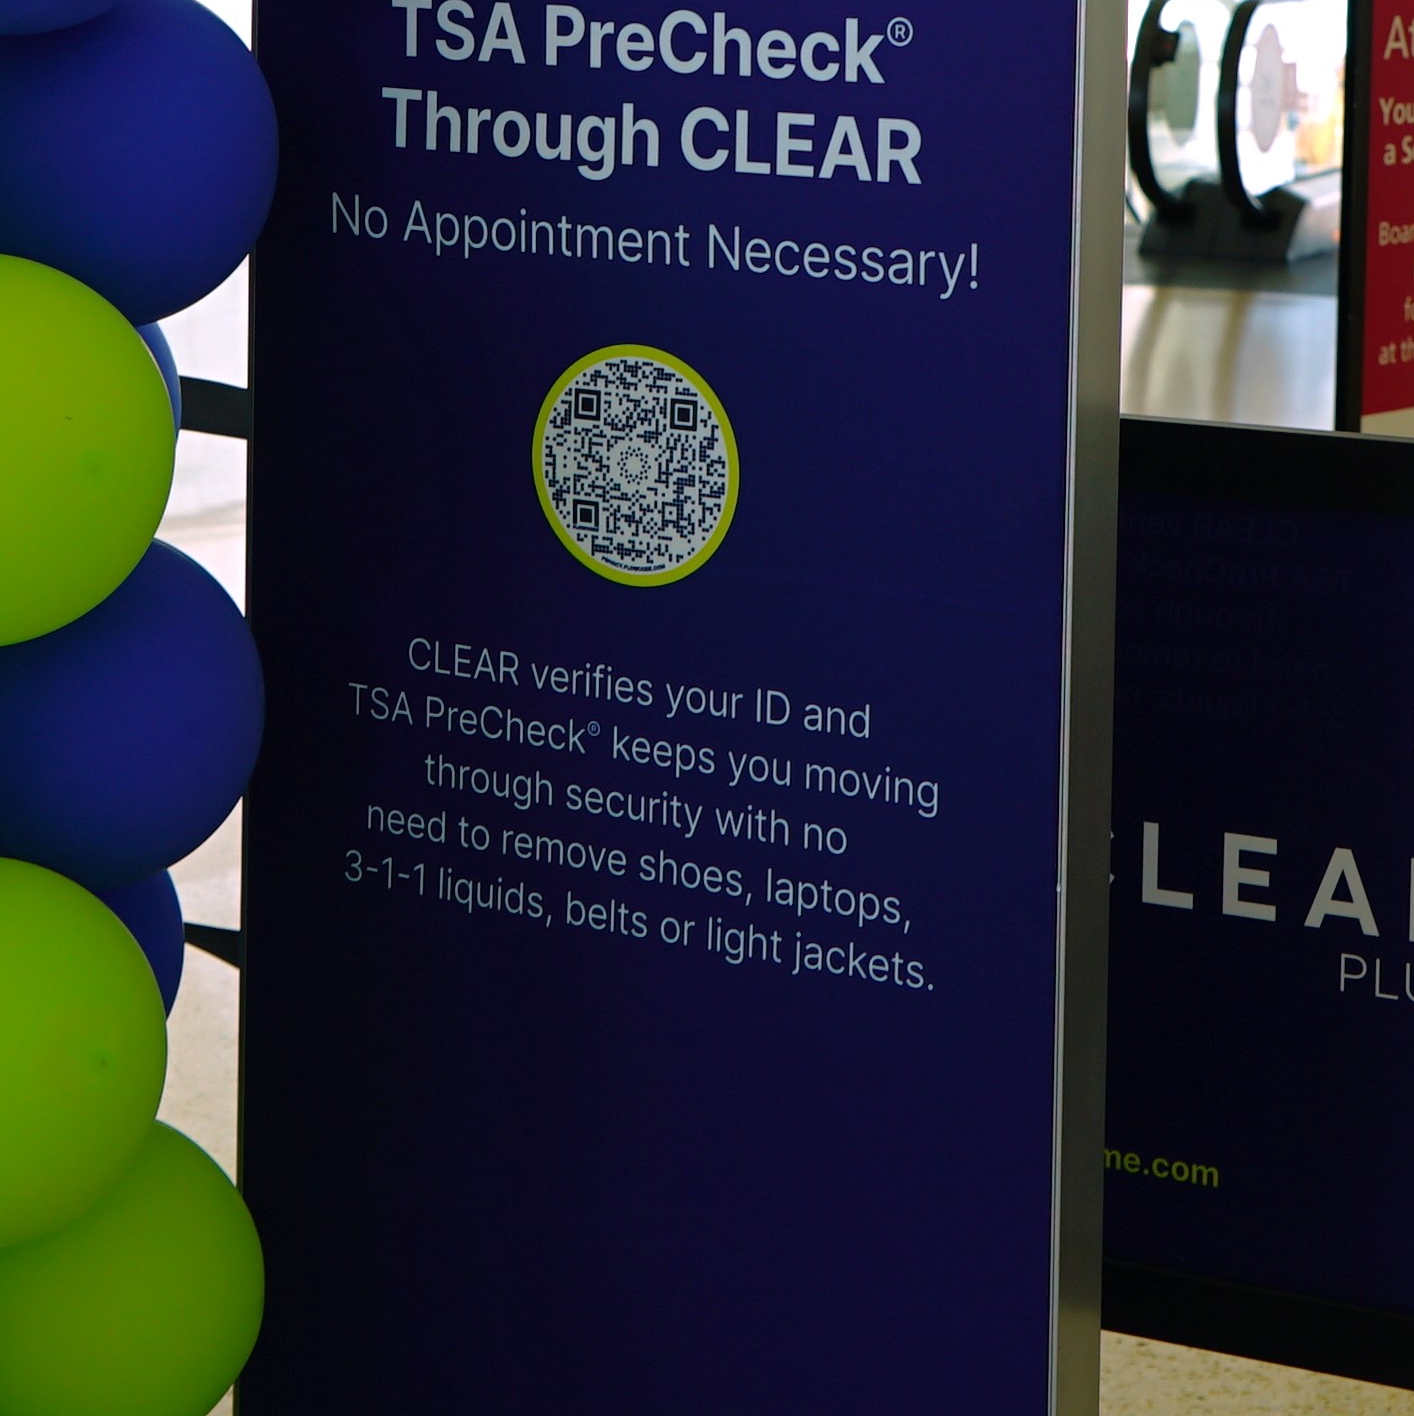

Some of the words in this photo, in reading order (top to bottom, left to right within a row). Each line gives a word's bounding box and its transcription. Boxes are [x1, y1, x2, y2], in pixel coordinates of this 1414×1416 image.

[382, 87, 660, 180] Through
[681, 107, 921, 184] CLEAR
[1383, 143, 1396, 166] a
[332, 192, 388, 238] No
[404, 200, 690, 266] Appointment
[708, 223, 980, 299] Necessary!
[409, 638, 519, 685] CLEAR
[531, 660, 653, 708] verifies
[666, 682, 743, 737] your
[755, 688, 790, 726] ID
[804, 703, 871, 739] and
[348, 682, 412, 726] TSA
[612, 726, 714, 778] keeps
[727, 746, 791, 787] you
[804, 760, 939, 818] moving
[424, 754, 553, 810] through
[566, 784, 703, 838] security
[715, 805, 788, 845] with
[804, 823, 847, 854] no
[344, 850, 427, 896] 3-1-1
[439, 867, 553, 928] liquids,
[567, 891, 648, 940] belts
[660, 915, 695, 946] or
[707, 917, 782, 966] light
[792, 932, 935, 991] jackets.
[368, 805, 446, 843] need
[459, 816, 490, 850] to
[502, 830, 627, 875] remove
[639, 850, 752, 906] shoes,
[766, 868, 912, 933] laptops,
